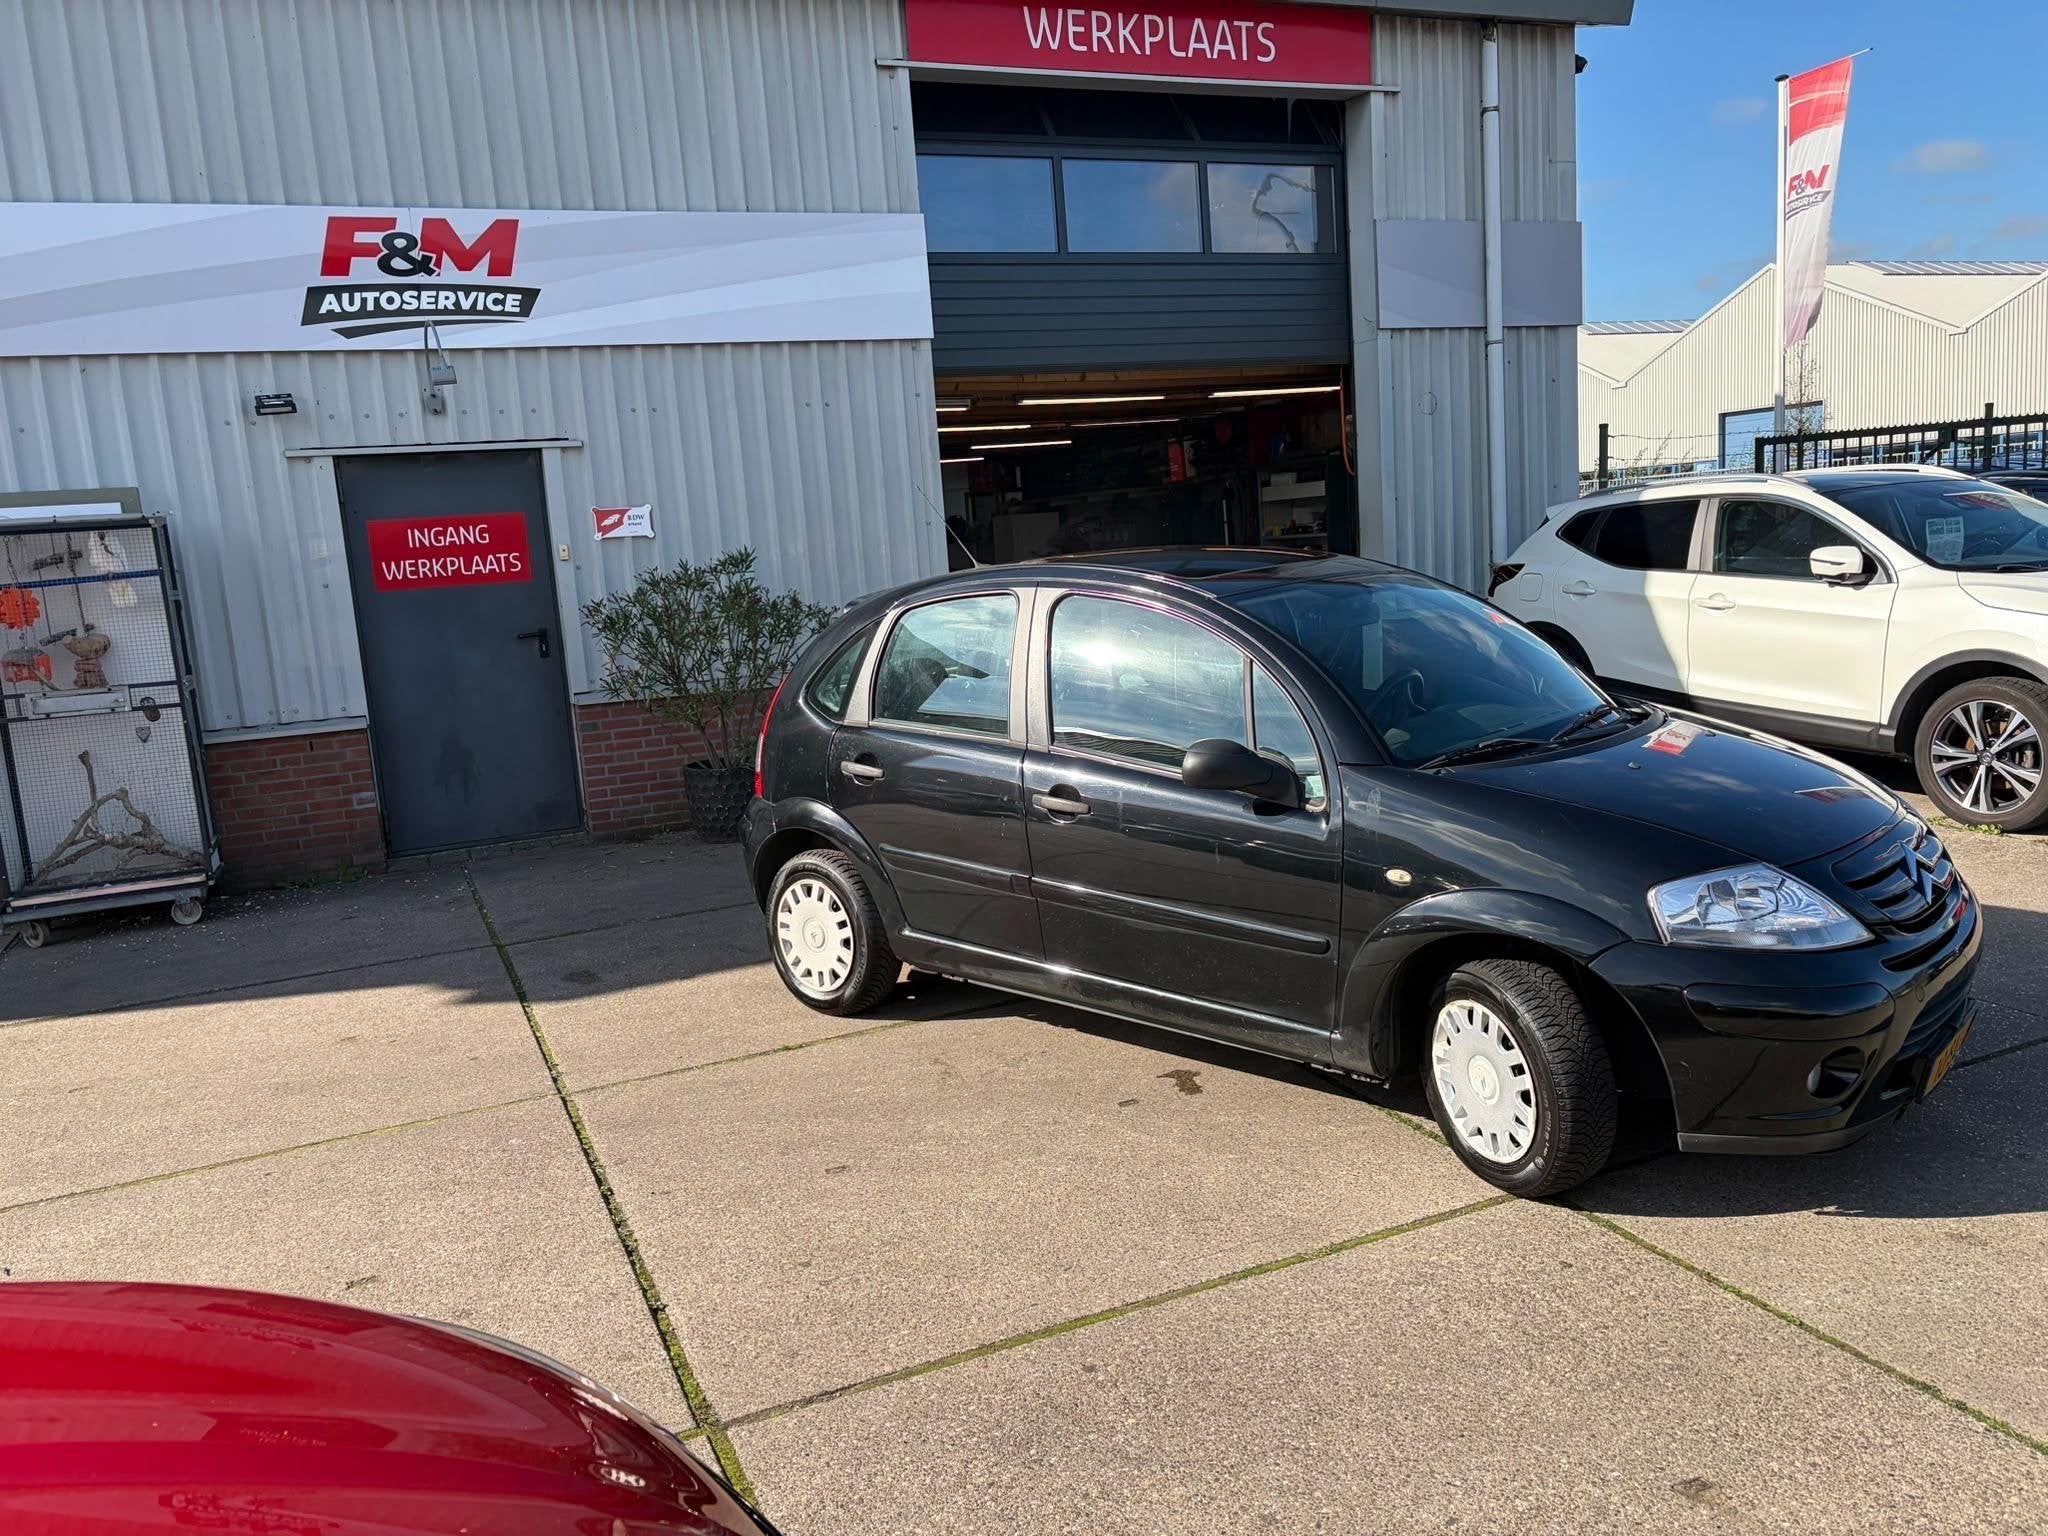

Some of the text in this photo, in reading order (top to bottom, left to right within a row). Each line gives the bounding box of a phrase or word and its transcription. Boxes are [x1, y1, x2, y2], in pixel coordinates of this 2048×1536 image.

[1022, 5, 1277, 64] WERKPLAATS
[319, 216, 520, 278] F&M
[318, 290, 523, 315] AUTOSERVICE
[407, 524, 490, 549] INGANG
[381, 552, 522, 581] WERKPLAATS
